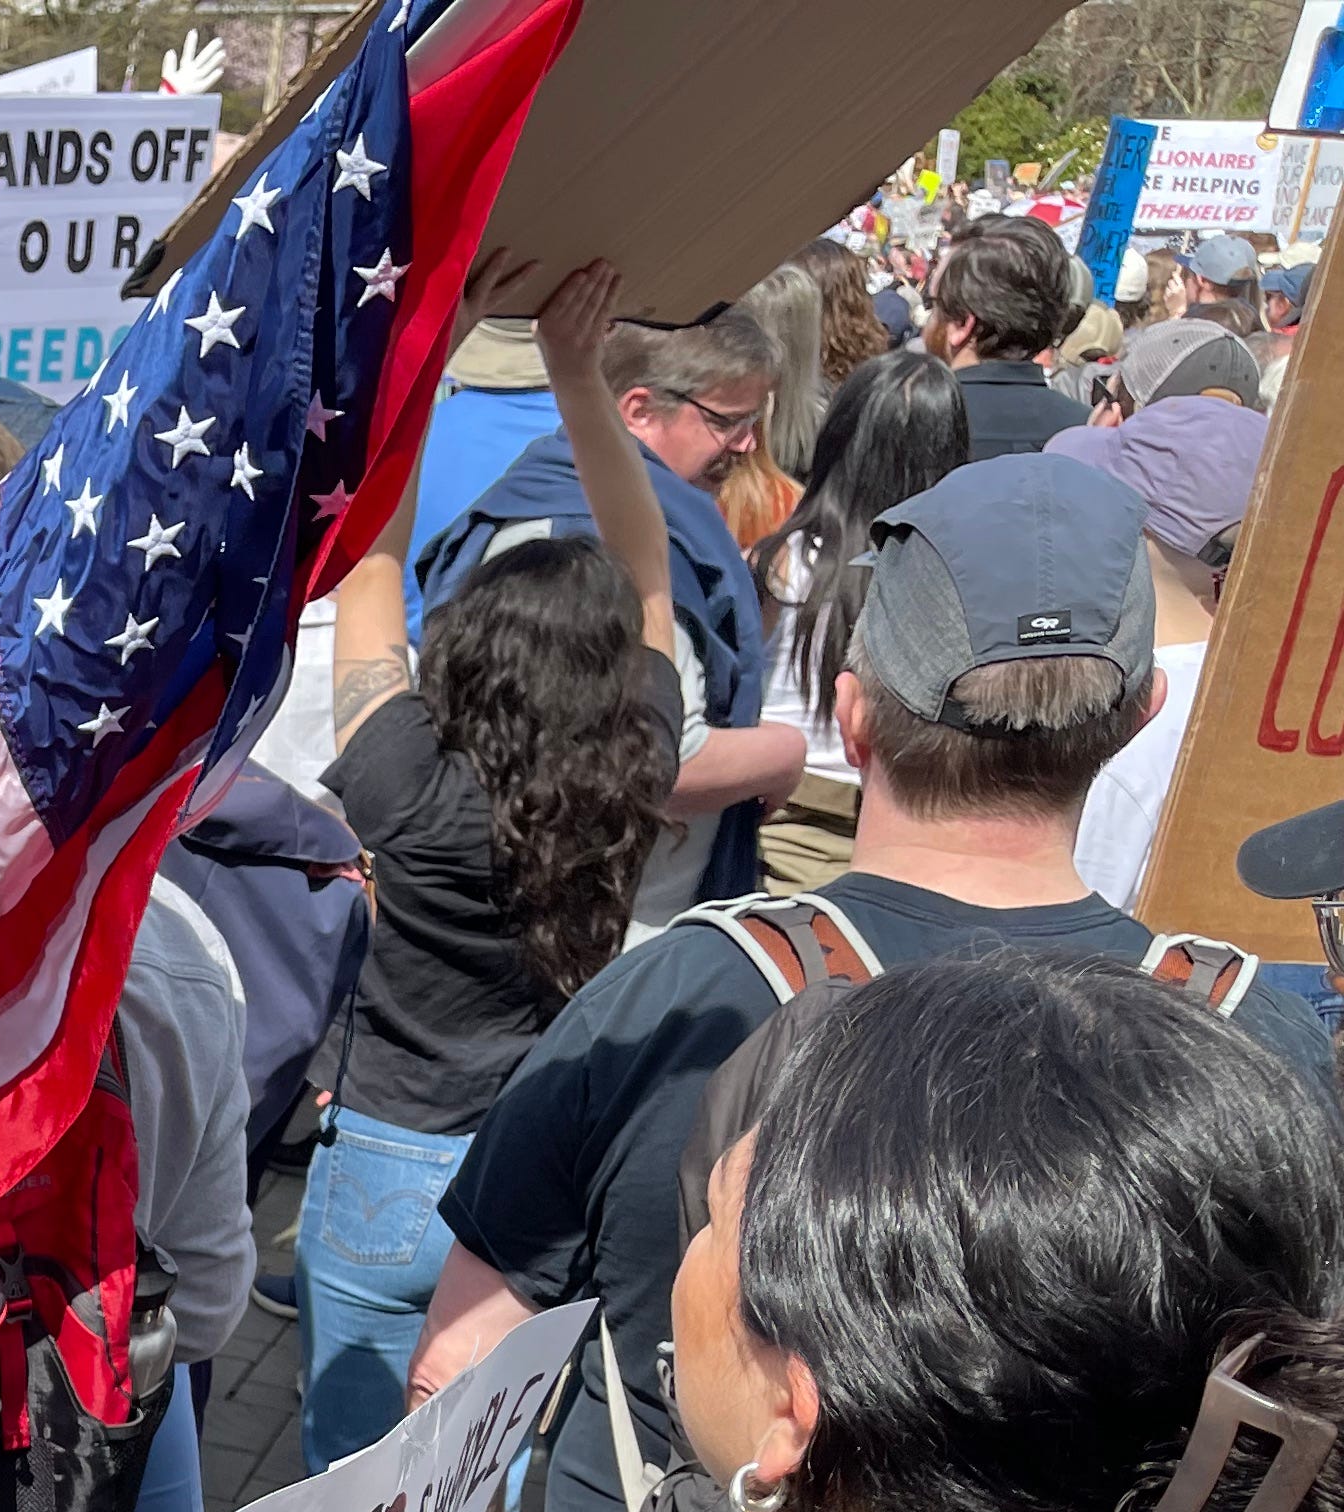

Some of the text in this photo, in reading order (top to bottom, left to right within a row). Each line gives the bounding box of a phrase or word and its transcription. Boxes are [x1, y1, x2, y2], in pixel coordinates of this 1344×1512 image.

[131, 128, 210, 182] OFF
[1172, 175, 1260, 195] HELPING
[1139, 203, 1259, 222] THEMSELVES
[19, 216, 141, 274] OUR
